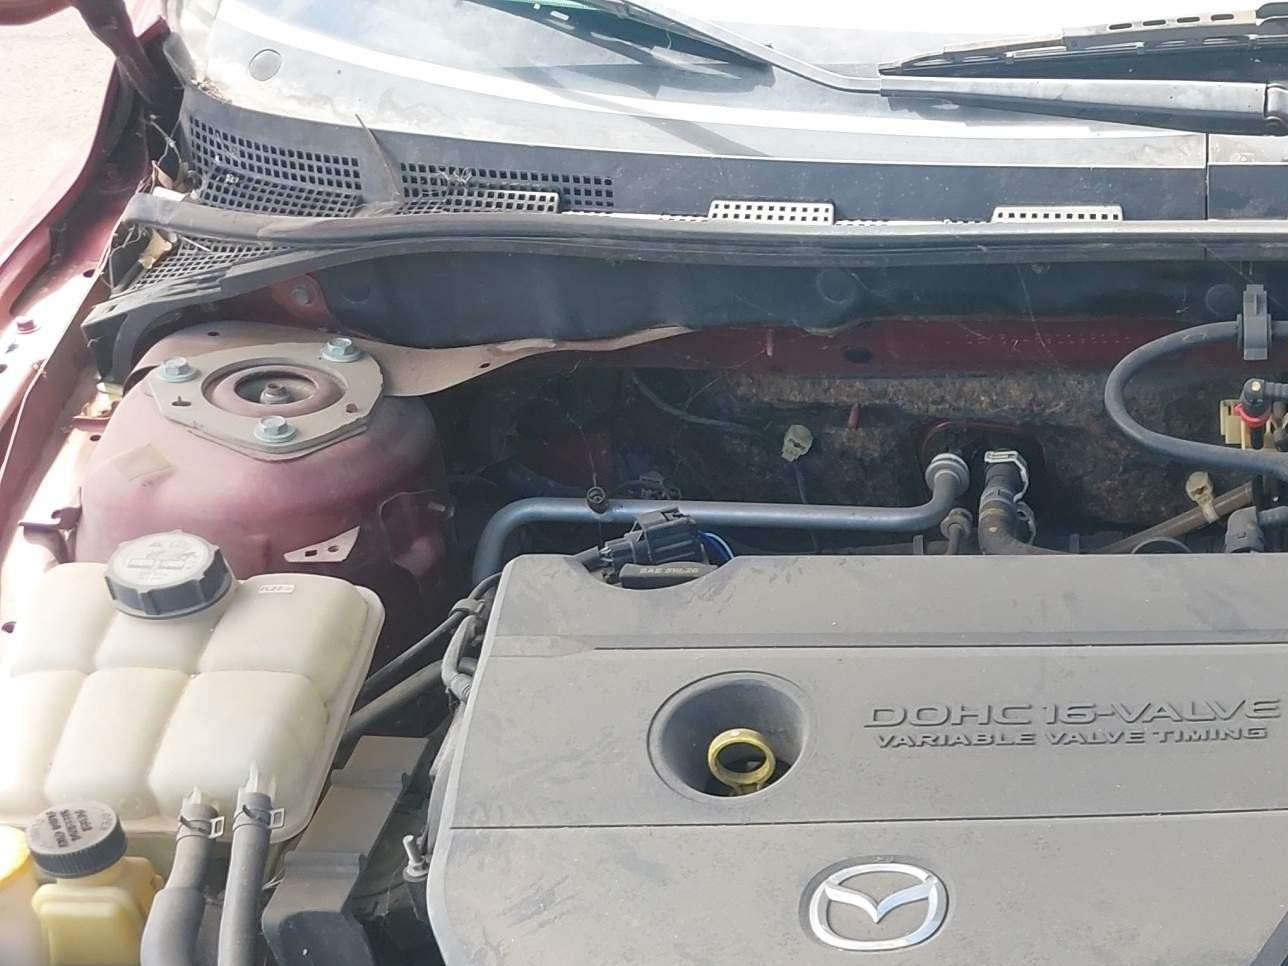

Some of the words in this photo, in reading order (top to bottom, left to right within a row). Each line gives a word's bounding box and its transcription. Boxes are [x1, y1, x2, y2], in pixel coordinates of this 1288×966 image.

[640, 567, 662, 575] SAE
[863, 703, 1033, 729] DOHC
[1041, 698, 1283, 726] 16-VALVE
[876, 731, 1037, 749] VARIABLE
[1045, 730, 1146, 746] VALVE
[1152, 727, 1269, 744] TIMING
